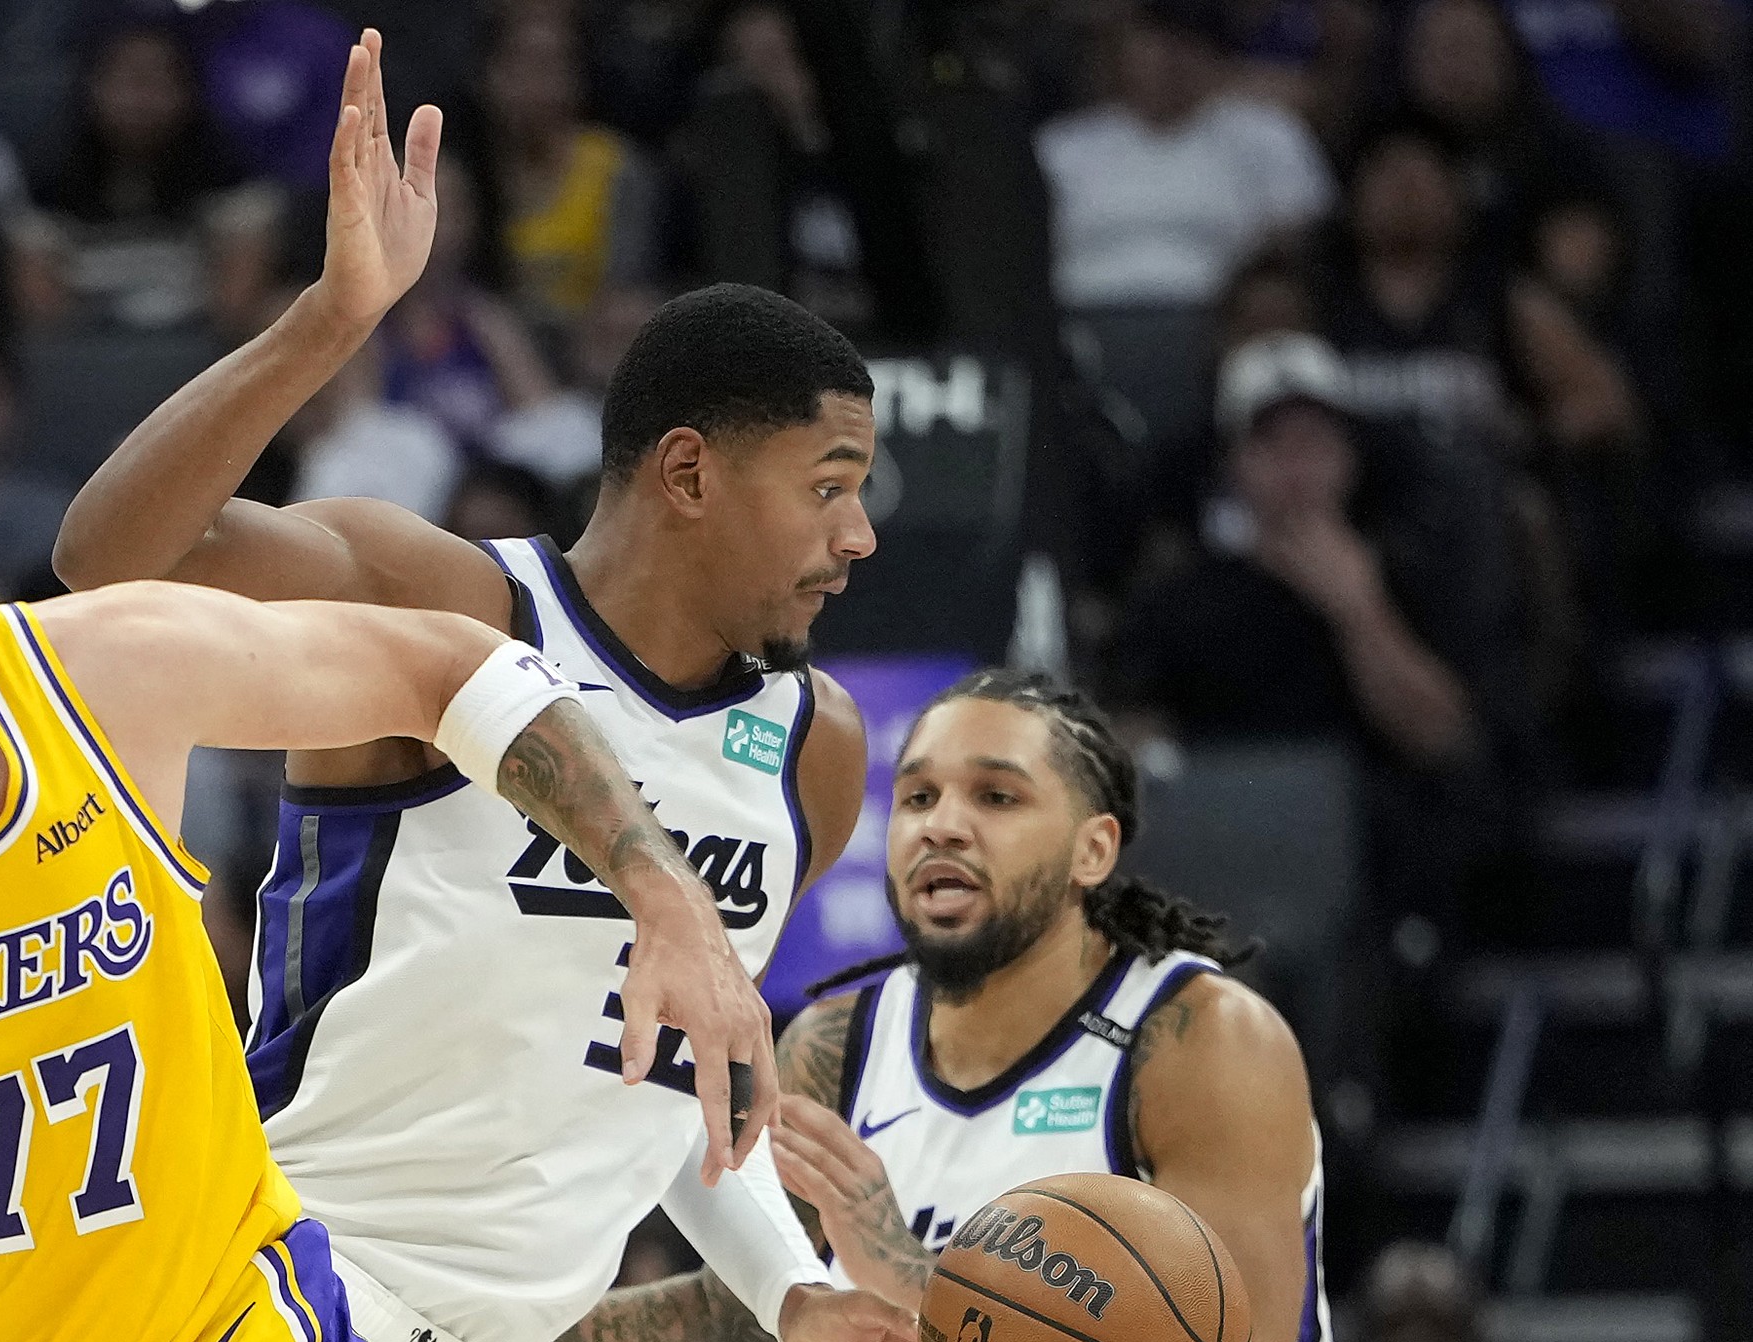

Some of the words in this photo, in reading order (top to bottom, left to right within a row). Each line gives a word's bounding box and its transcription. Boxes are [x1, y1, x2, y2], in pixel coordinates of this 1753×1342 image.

[748, 742, 780, 768] Health
[751, 725, 783, 749] Sutter
[37, 792, 105, 865] Albert
[951, 1206, 1115, 1321] Wilson
